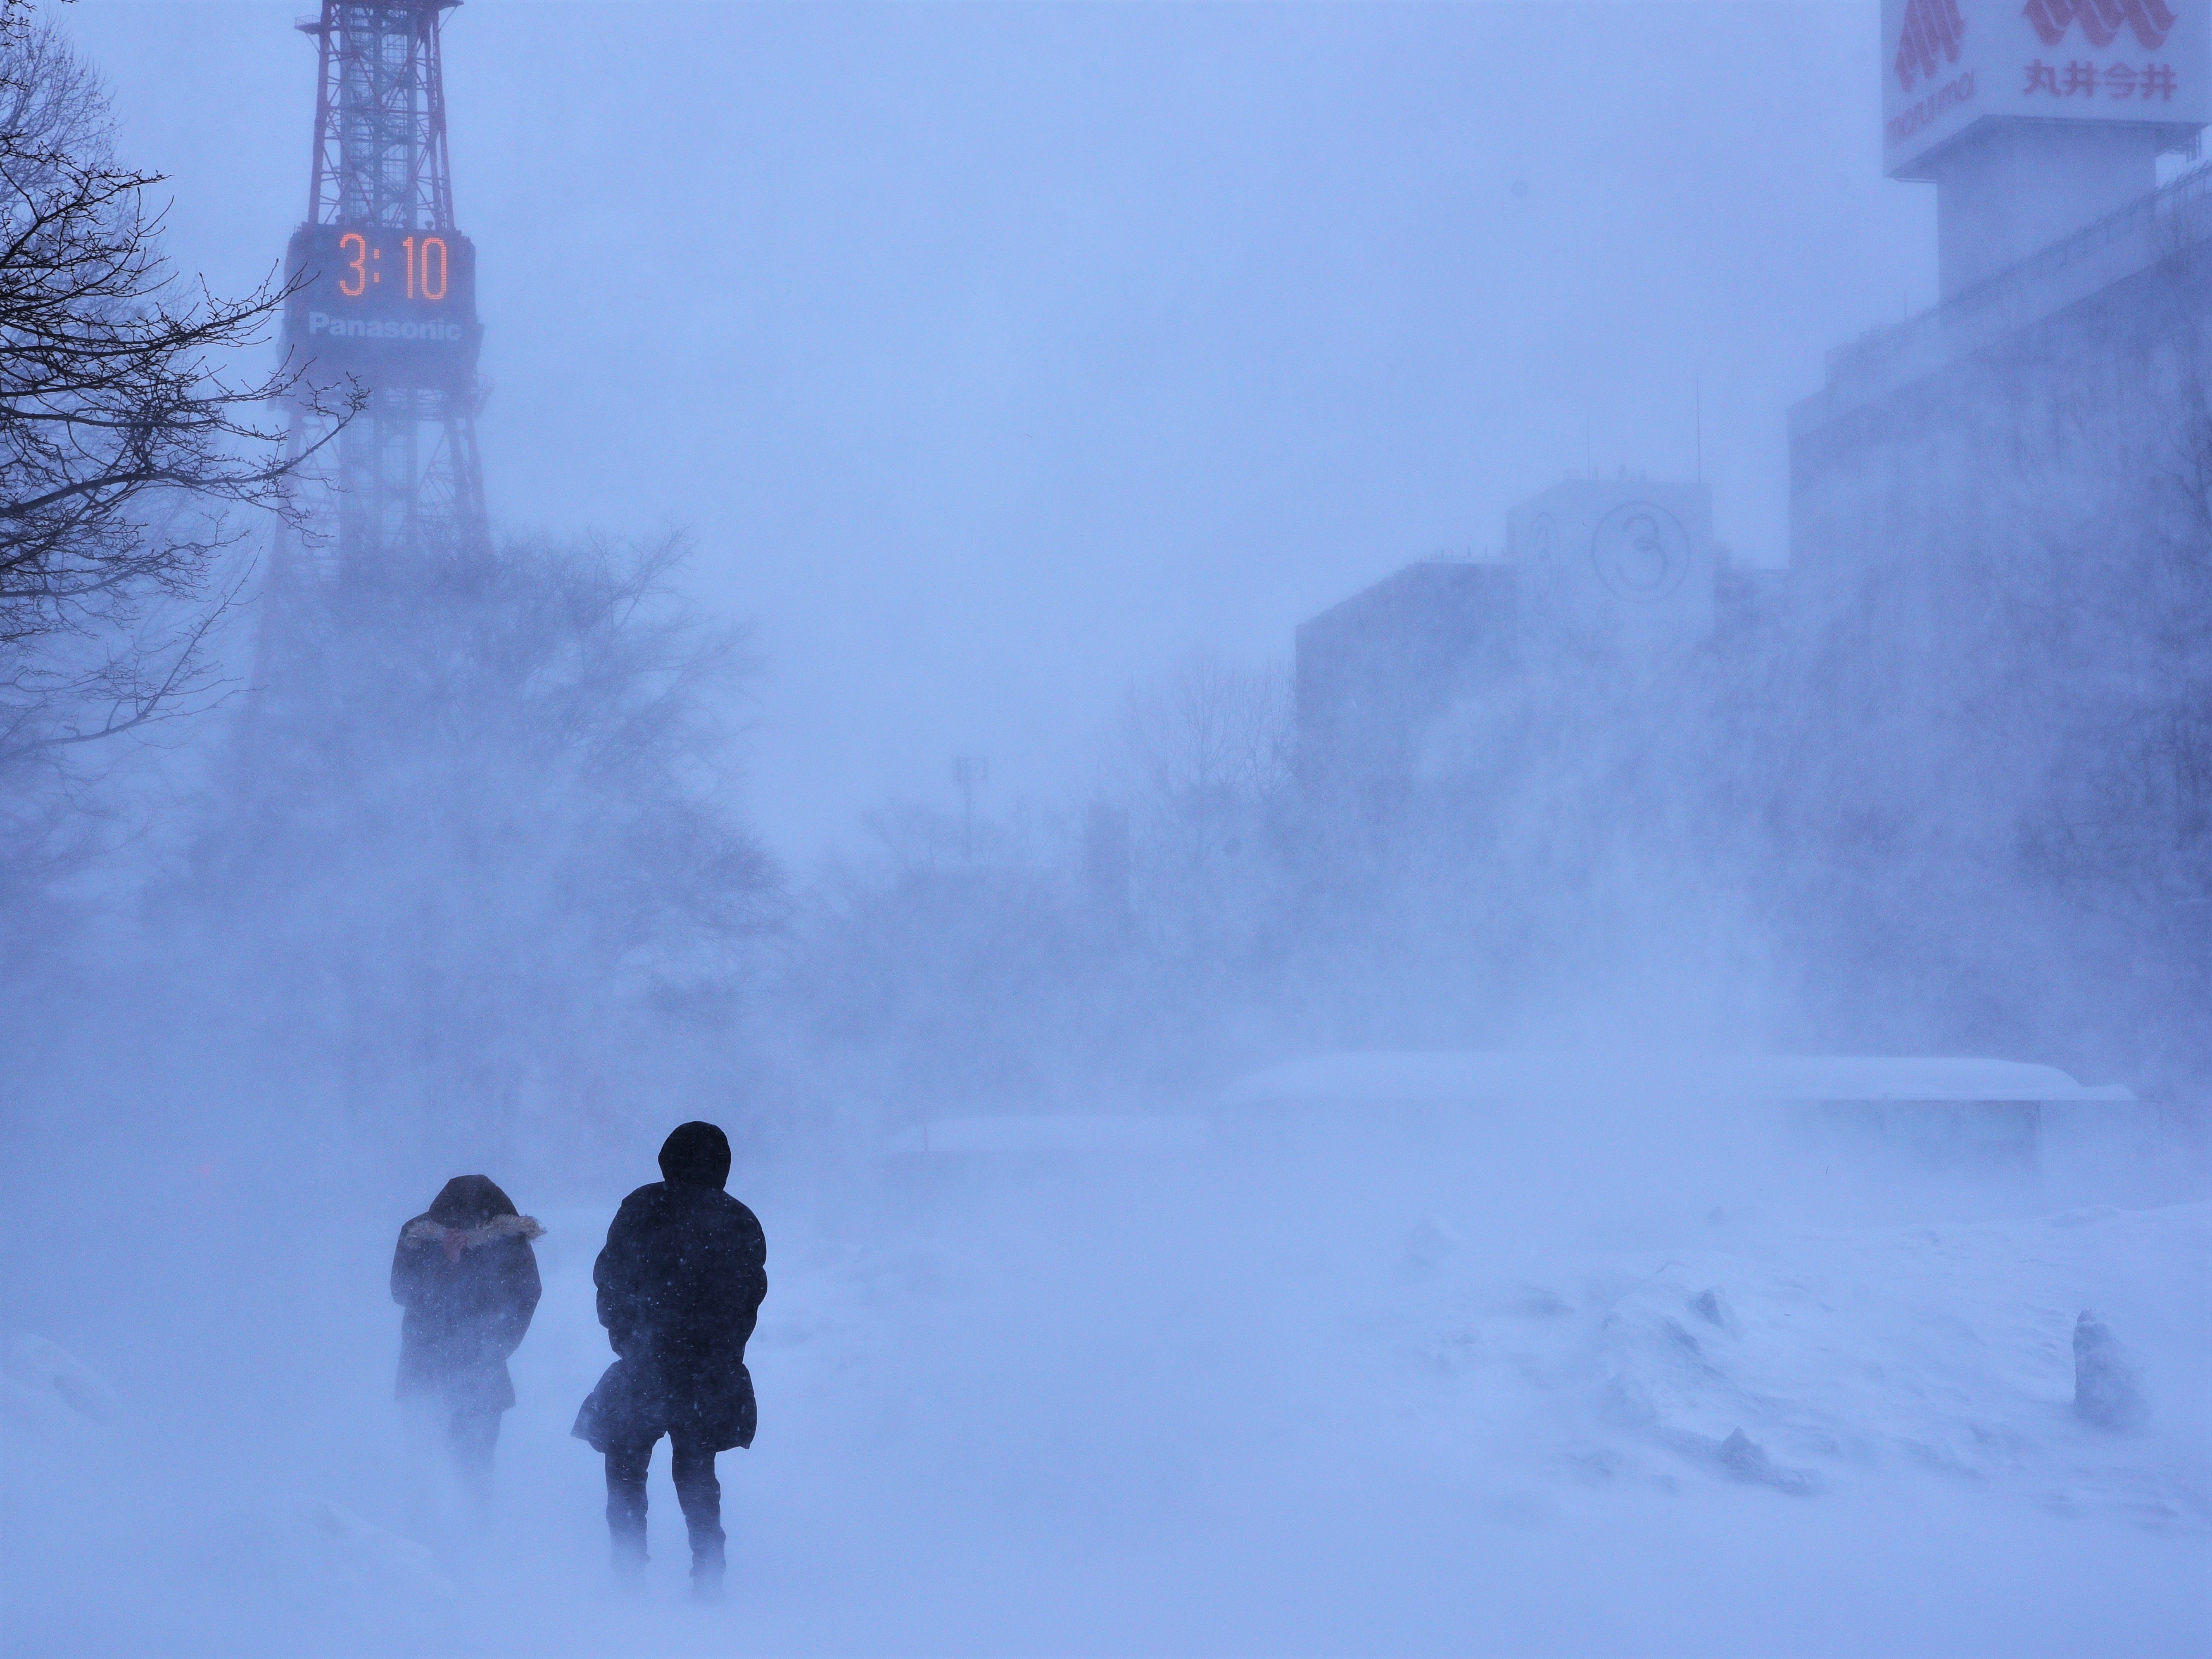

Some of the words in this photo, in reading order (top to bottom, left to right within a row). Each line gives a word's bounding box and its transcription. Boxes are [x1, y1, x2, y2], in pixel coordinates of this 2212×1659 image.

[2023, 59, 2178, 101] 丸井今井
[340, 233, 447, 299] 3:10
[309, 312, 462, 341] Panasonic
